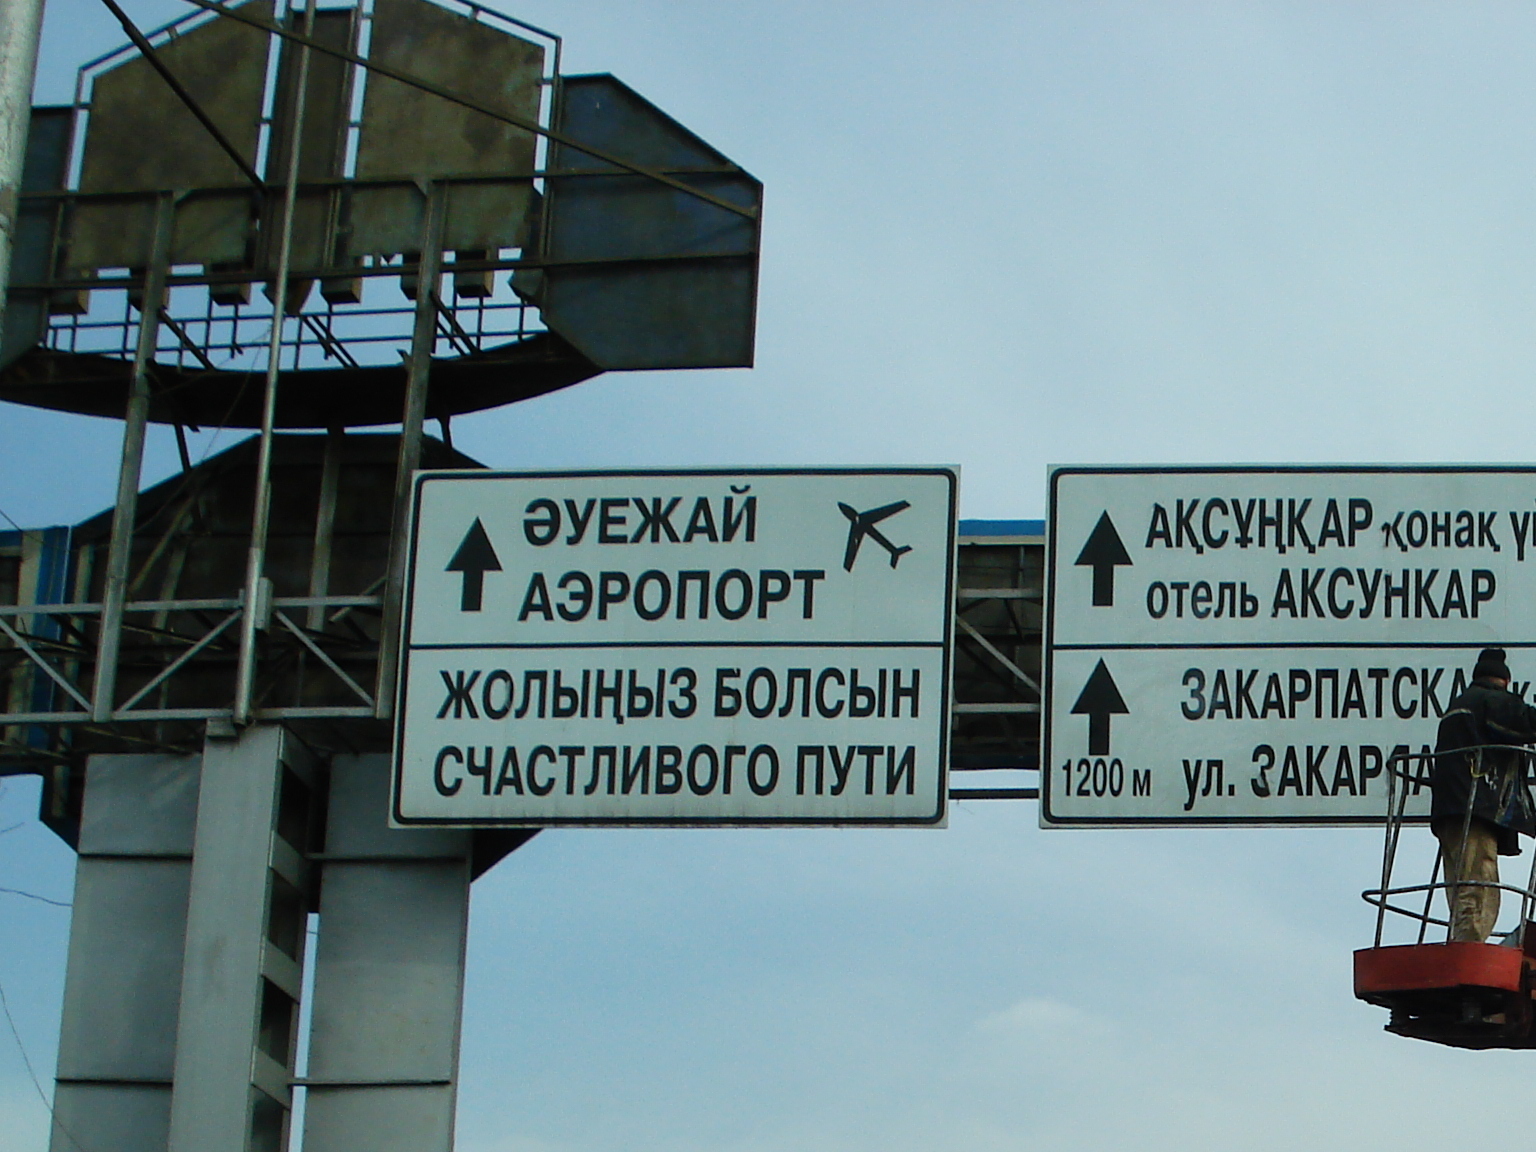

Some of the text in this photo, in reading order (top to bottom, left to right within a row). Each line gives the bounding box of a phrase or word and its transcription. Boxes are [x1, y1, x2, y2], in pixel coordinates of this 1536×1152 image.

[521, 484, 758, 547] ӘУЕЖАЙ
[1144, 496, 1374, 555] АҚСҰҢҚАР
[516, 568, 826, 622] АЭРОПОРТ
[1145, 566, 1498, 620] отель АКСУНКАР
[434, 666, 921, 725] ЖОЛЫҢЫЗ БОЛСЫН
[1180, 666, 1478, 720] ЗАКАРПАТСКА
[433, 743, 917, 797] СЧАСТЛИВОГО ПУТИ
[1061, 756, 1152, 798] 1200 м
[1182, 757, 1236, 811] ул.
